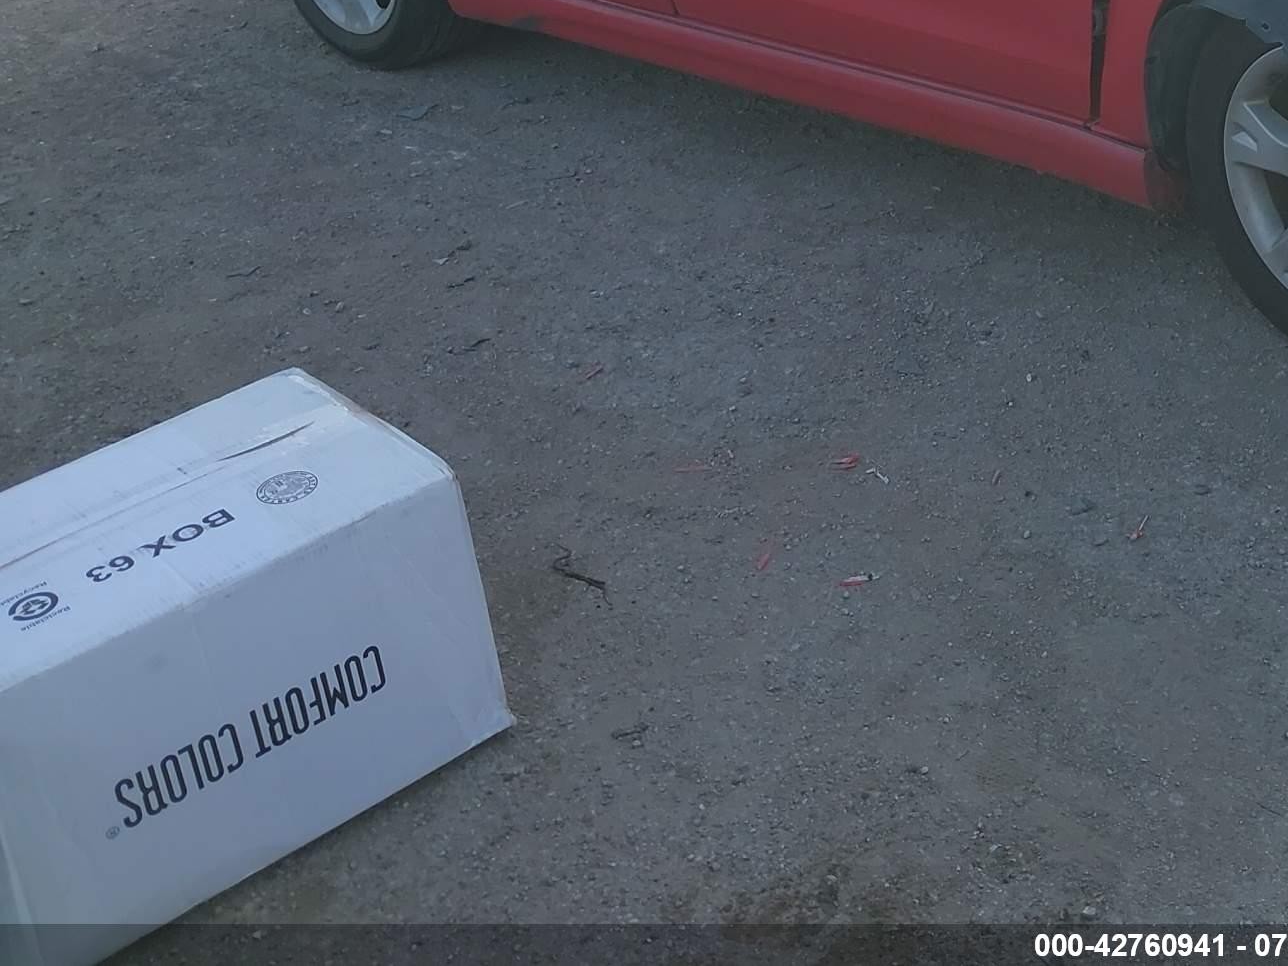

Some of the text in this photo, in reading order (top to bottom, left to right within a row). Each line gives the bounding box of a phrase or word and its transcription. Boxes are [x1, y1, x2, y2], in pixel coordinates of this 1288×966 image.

[86, 508, 235, 583] BOX 63
[114, 645, 387, 829] COMFORT COLORS
